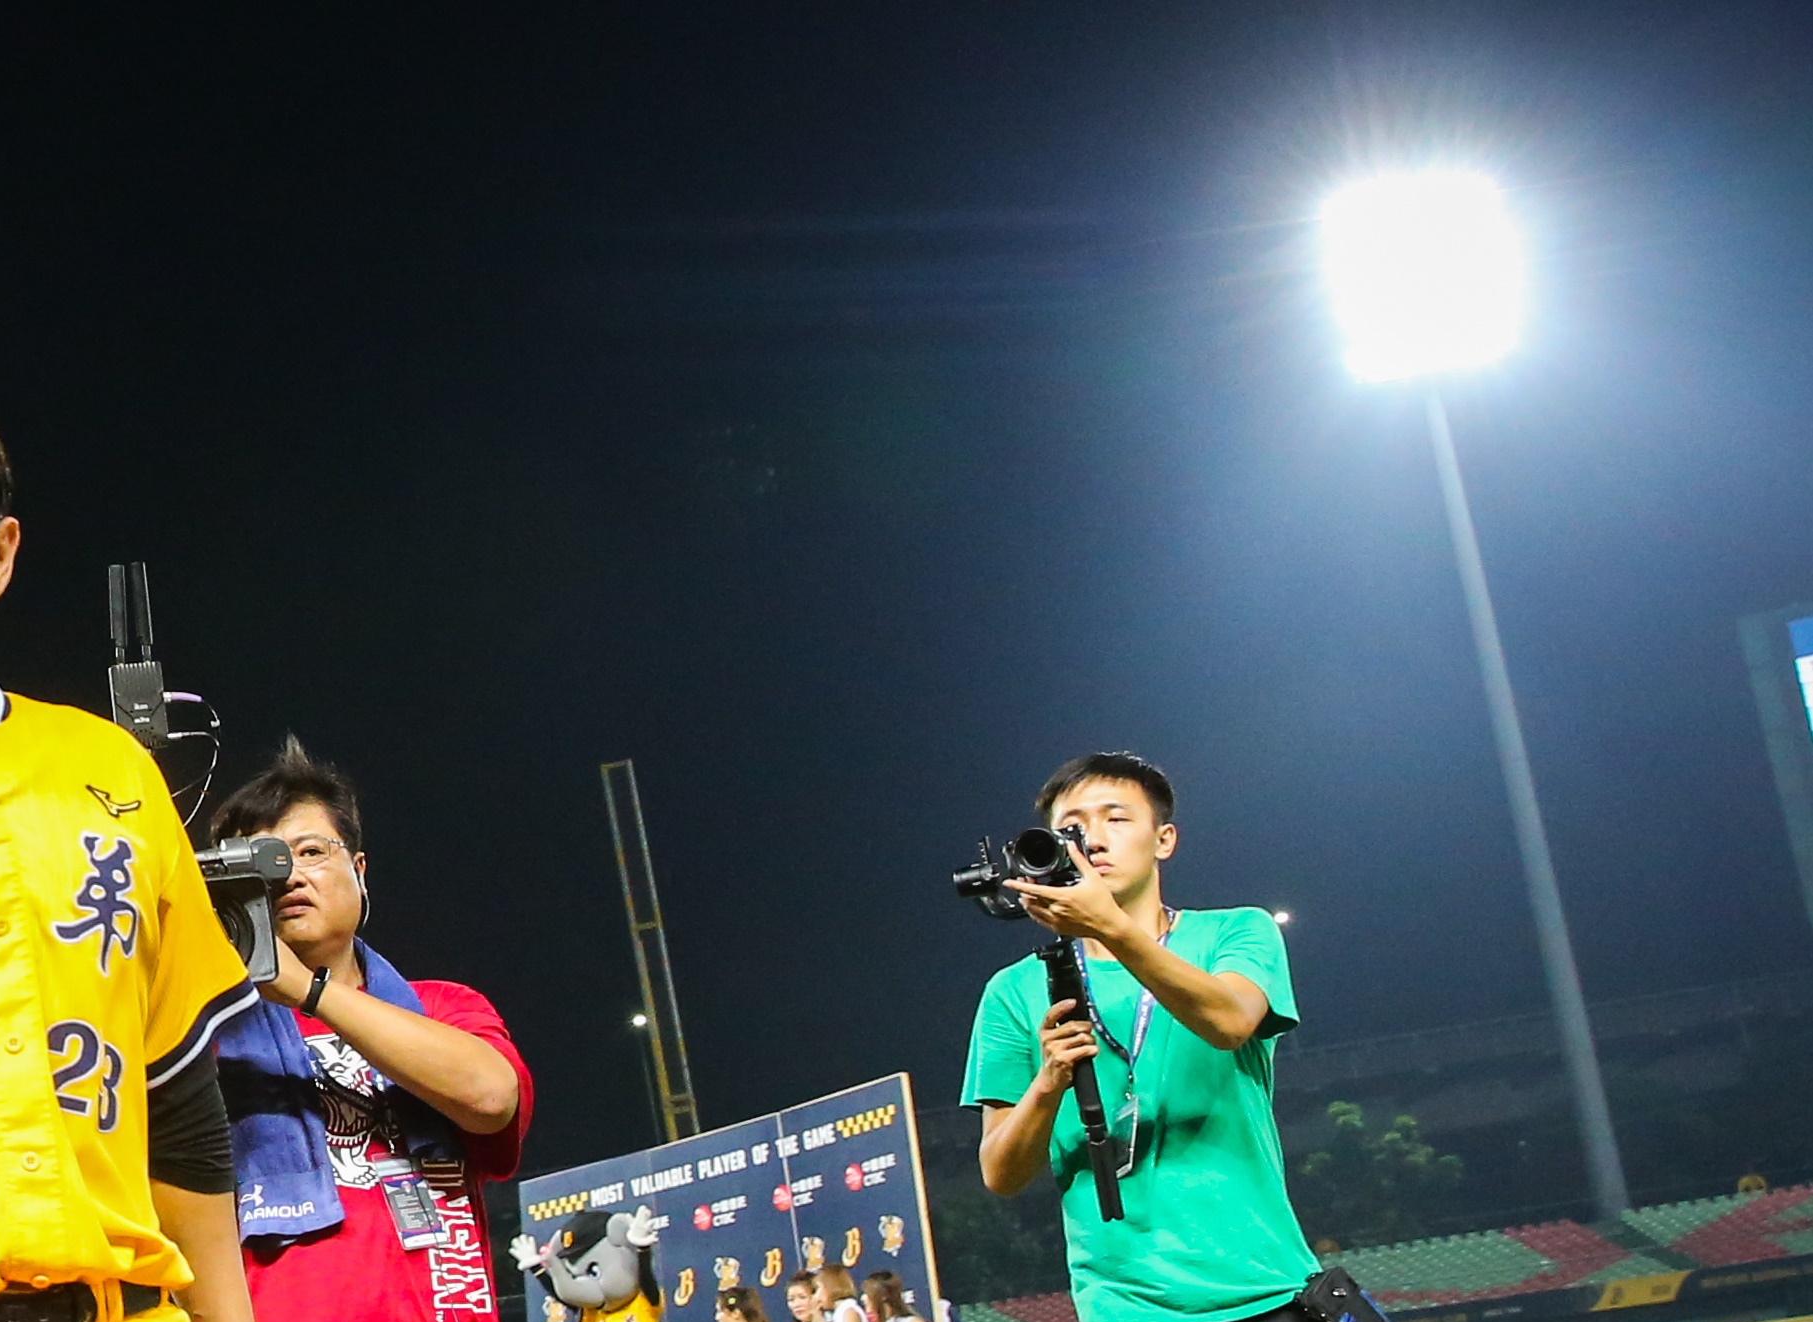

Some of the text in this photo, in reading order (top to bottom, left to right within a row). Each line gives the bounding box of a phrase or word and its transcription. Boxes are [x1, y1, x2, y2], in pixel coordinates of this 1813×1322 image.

[47, 1019, 123, 1134] 23
[590, 1122, 837, 1208] MOST VALUABLE PLAYER OF THE GAME
[242, 1201, 316, 1223] ARMOUR
